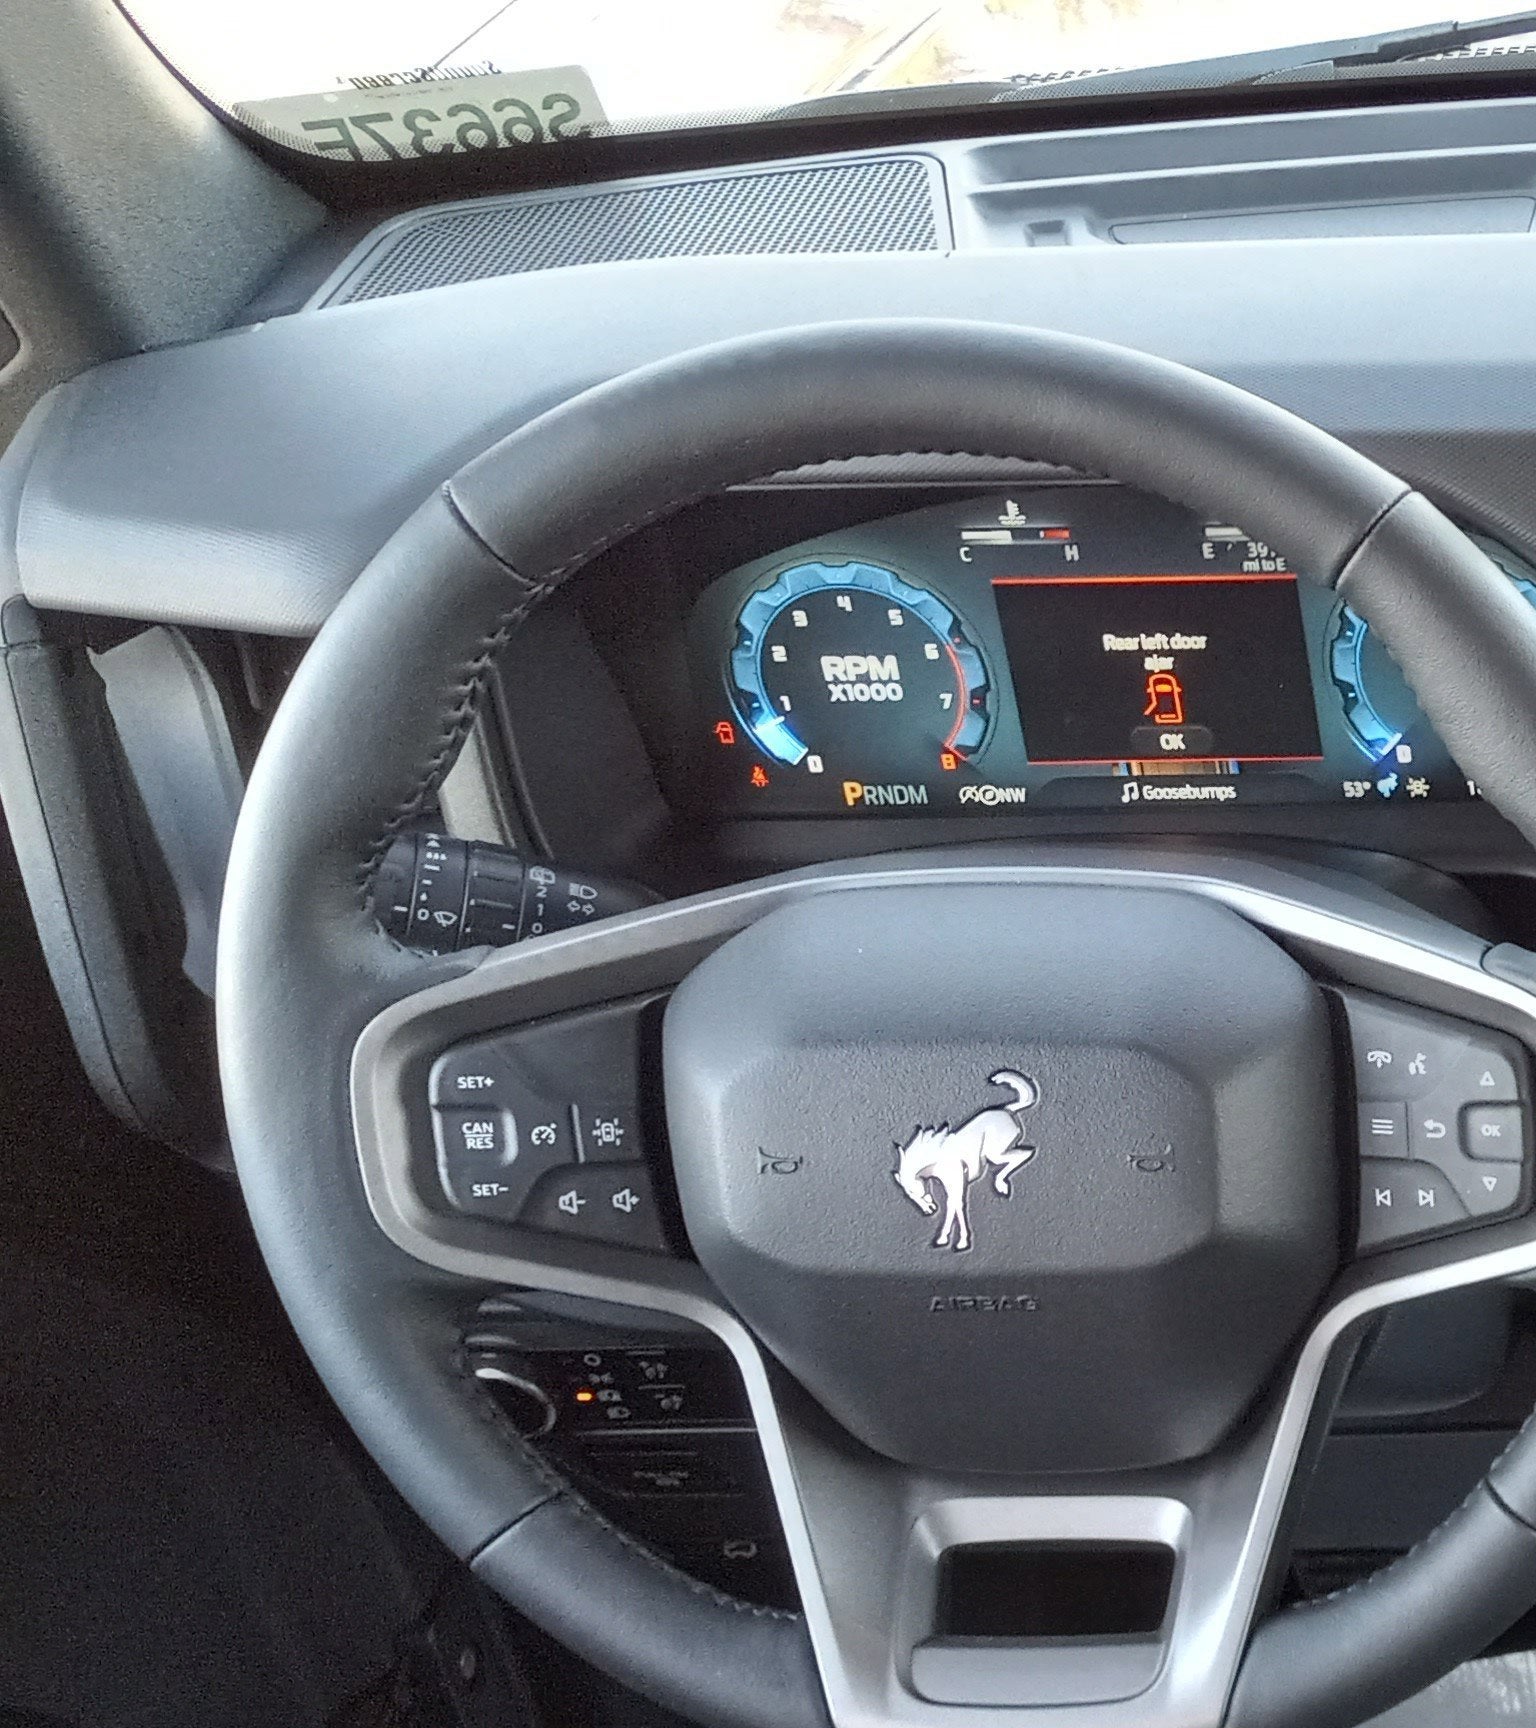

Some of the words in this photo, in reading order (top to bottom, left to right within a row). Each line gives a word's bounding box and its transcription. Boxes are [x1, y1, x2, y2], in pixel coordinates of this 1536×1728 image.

[959, 546, 973, 563] C
[1064, 545, 1080, 561] H
[1202, 543, 1215, 560] E
[836, 595, 853, 613] 4
[791, 611, 808, 628] 3
[887, 609, 905, 626] 5
[1102, 633, 1139, 652] Rear
[1140, 632, 1170, 651] left
[1170, 632, 1208, 650] door
[771, 645, 788, 663] 2
[924, 643, 940, 660] 6
[820, 655, 901, 682] RPM
[829, 682, 904, 703] X1000
[779, 695, 792, 712] 1
[939, 693, 953, 710] 7
[1159, 732, 1187, 751] OK
[806, 754, 824, 774] 0
[941, 752, 958, 771] 8
[842, 780, 929, 807] PRNDM
[996, 786, 1027, 804] NW
[1142, 783, 1237, 804] Goosebumps
[536, 885, 547, 899] 2
[456, 1075, 495, 1091] SET+
[462, 1121, 494, 1135] CAN
[1481, 1124, 1502, 1138] OK
[465, 1136, 495, 1150] RES
